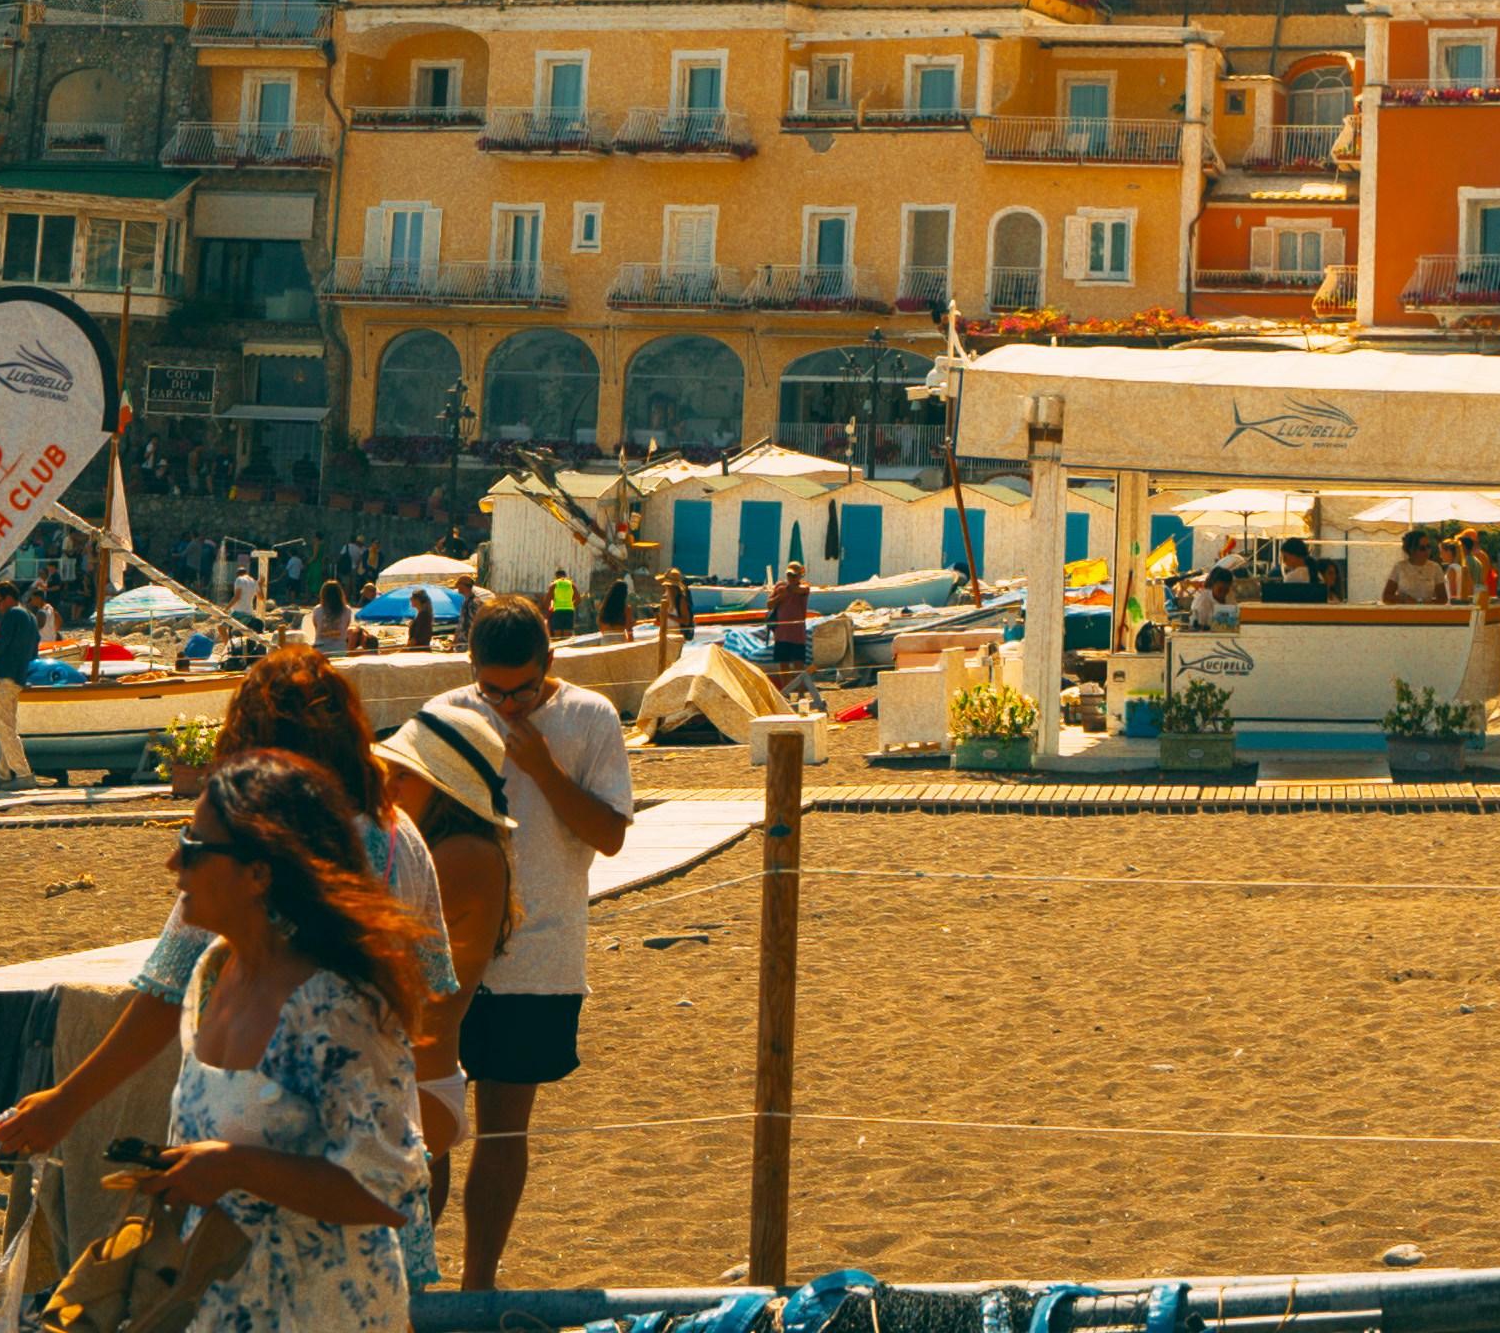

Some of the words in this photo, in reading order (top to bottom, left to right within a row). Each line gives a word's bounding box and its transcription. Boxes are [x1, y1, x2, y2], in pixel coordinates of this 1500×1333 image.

[6, 368, 74, 392] LUCIBELLO
[166, 369, 200, 380] COVO
[171, 379, 193, 390] DEI
[151, 388, 211, 401] SARACENI
[1276, 421, 1359, 439] LUCIBELLO
[9, 444, 67, 511] CLUB
[1200, 660, 1254, 671] LUCIBELLO
